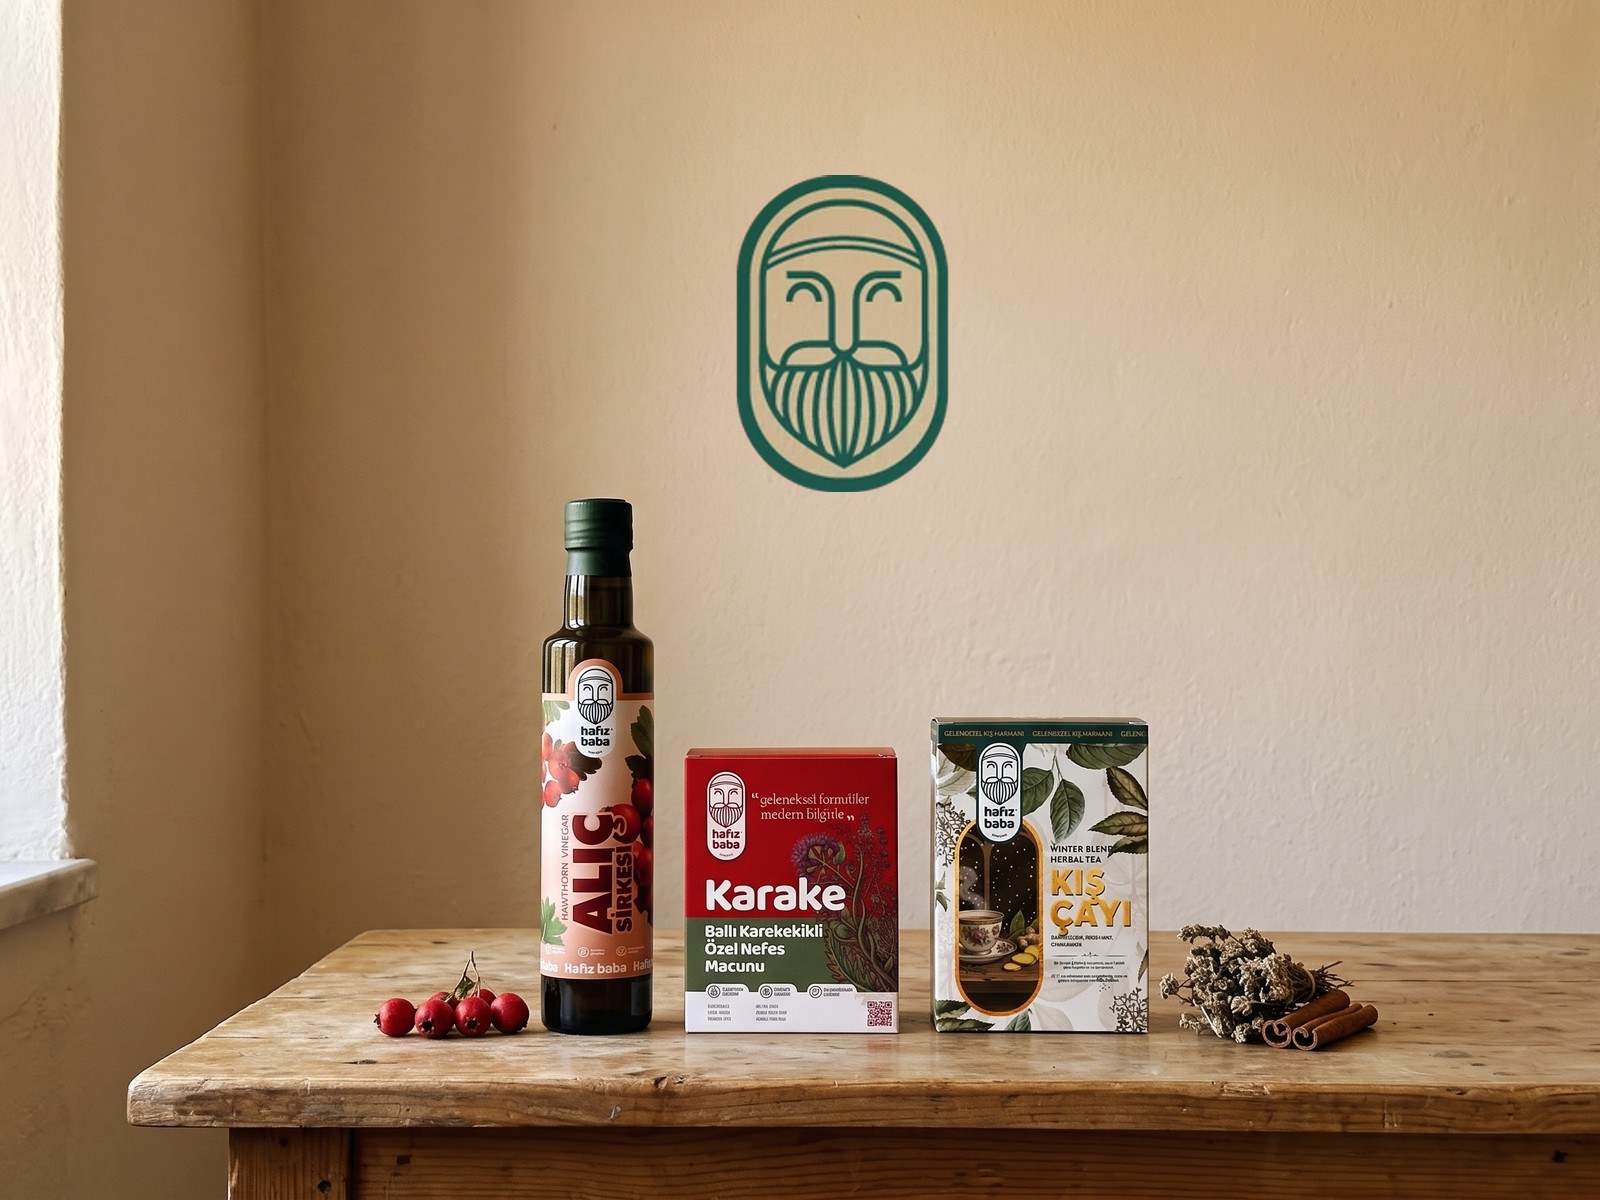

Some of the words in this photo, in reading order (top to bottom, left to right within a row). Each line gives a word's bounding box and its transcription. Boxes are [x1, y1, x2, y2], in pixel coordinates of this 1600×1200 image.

[581, 737, 610, 746] baba
[984, 818, 1015, 829] baba
[561, 814, 569, 858] VINEGAR
[712, 840, 740, 849] baba
[1050, 845, 1083, 853] WINTER
[561, 863, 569, 921] HAWTHORN
[1050, 868, 1106, 904] KIŞ
[705, 877, 846, 911] Karake
[1050, 899, 1132, 935] ÇAYI
[704, 924, 737, 938] Ballı
[739, 923, 823, 938] Karekekikli
[704, 938, 739, 955] Özel
[741, 941, 785, 955] Nefes
[597, 962, 627, 974] baba
[704, 959, 765, 973] Macunu
